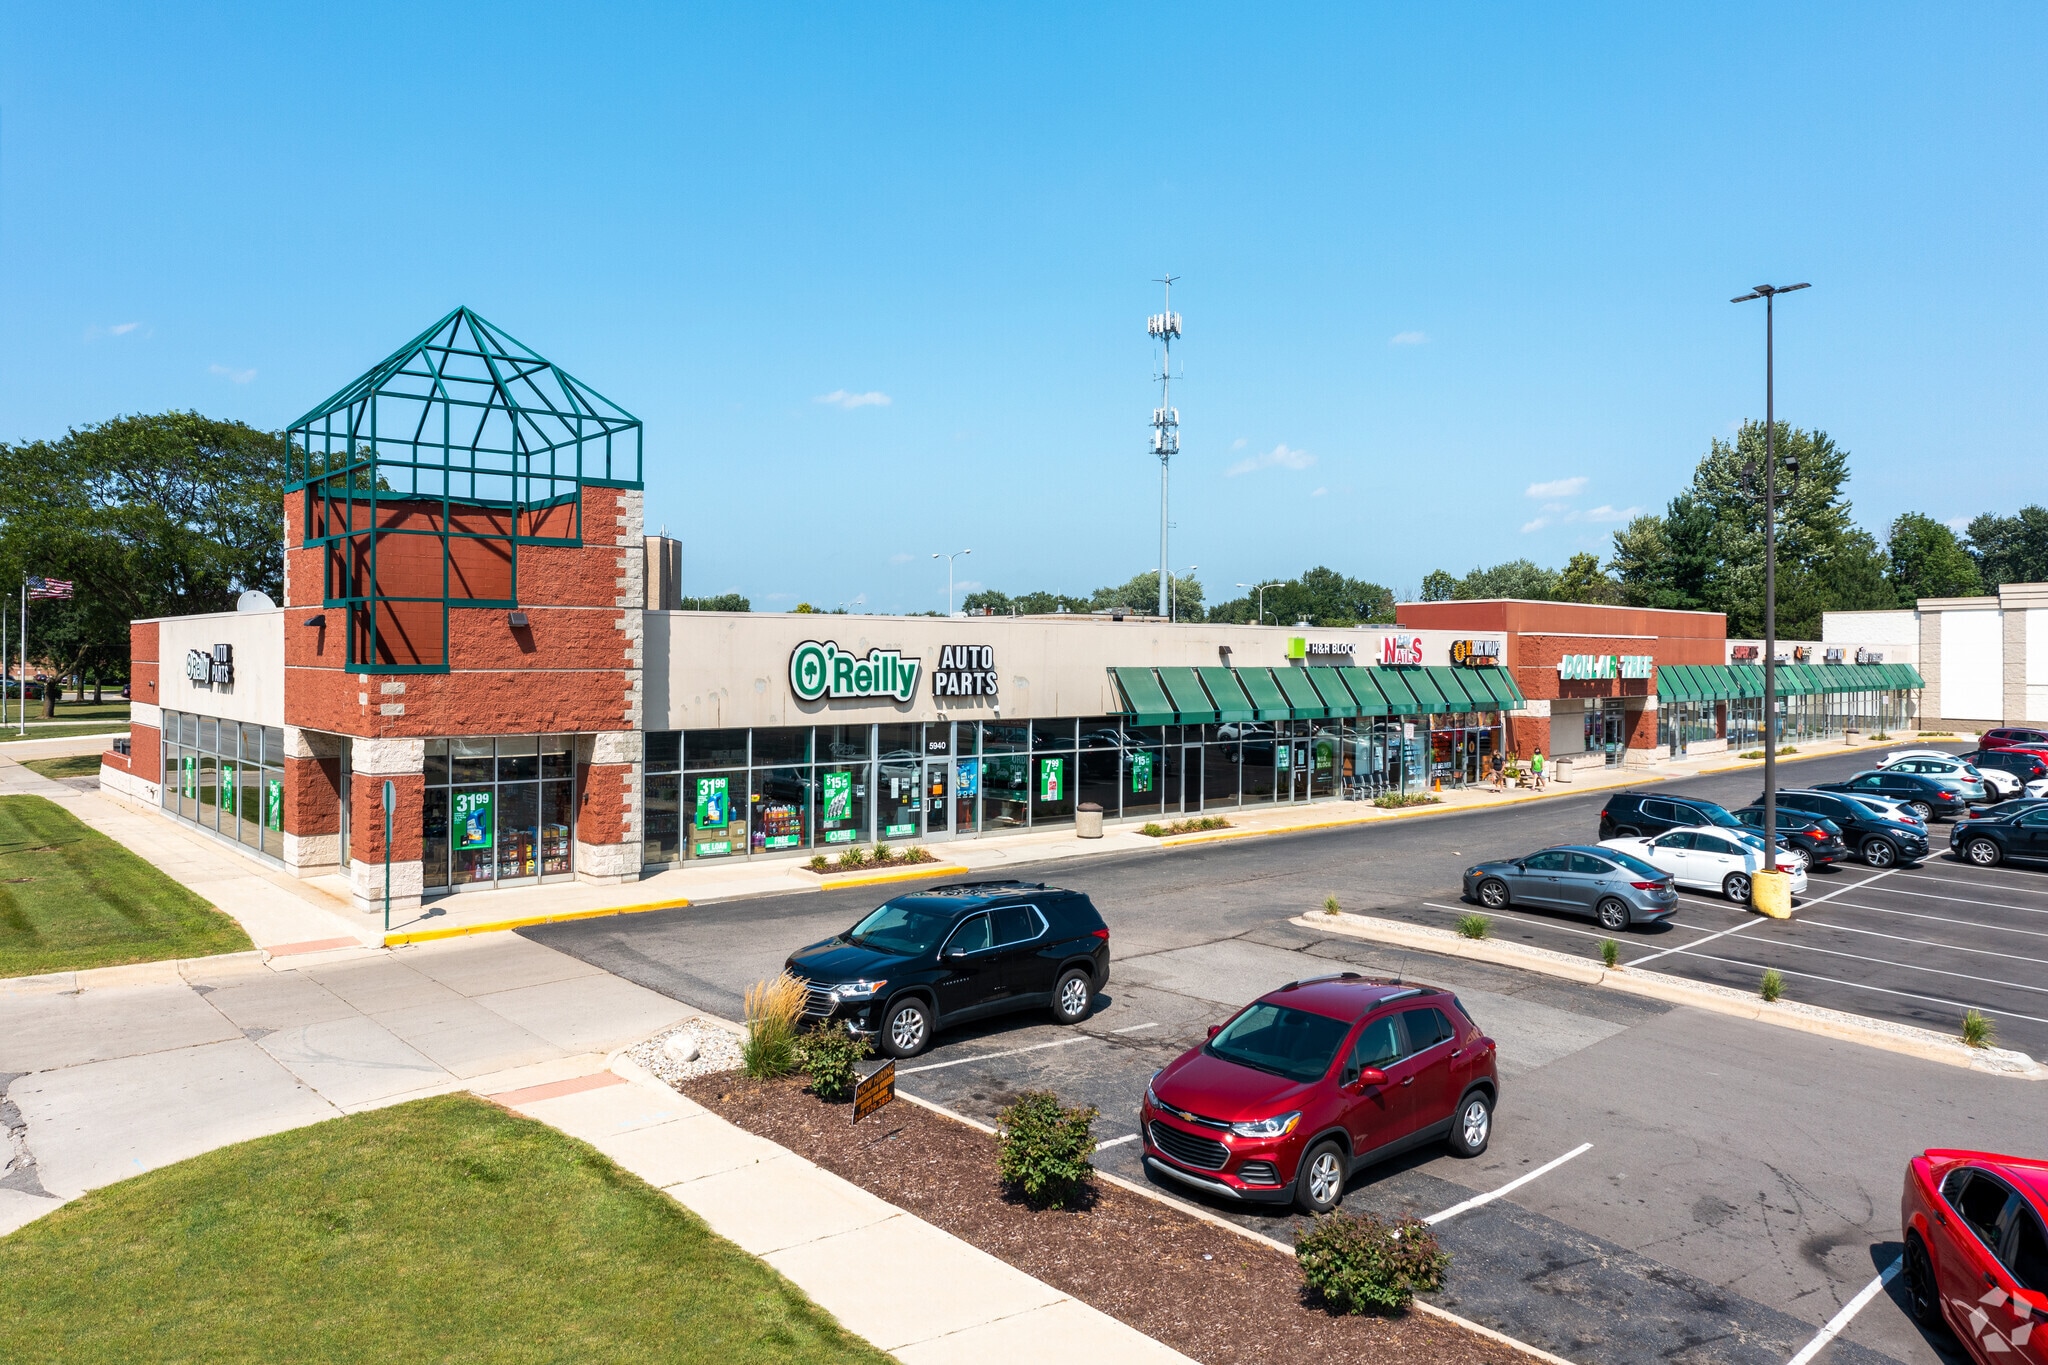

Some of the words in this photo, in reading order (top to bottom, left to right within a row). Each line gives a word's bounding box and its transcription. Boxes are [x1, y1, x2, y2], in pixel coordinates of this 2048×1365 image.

[941, 645, 994, 669] AUTO
[1312, 643, 1331, 654] H&R
[1332, 643, 1356, 654] BLOCK
[212, 665, 229, 683] PARTS
[794, 646, 916, 697] O'Reilly
[1561, 654, 1617, 679] DOLLAR
[1620, 655, 1653, 679] TREE
[935, 671, 998, 696] PARTS
[929, 741, 946, 750] 5940
[700, 843, 711, 851] WE
[774, 836, 788, 844] FREE
[858, 1078, 873, 1097] NOW
[873, 1063, 894, 1086] HIRING
